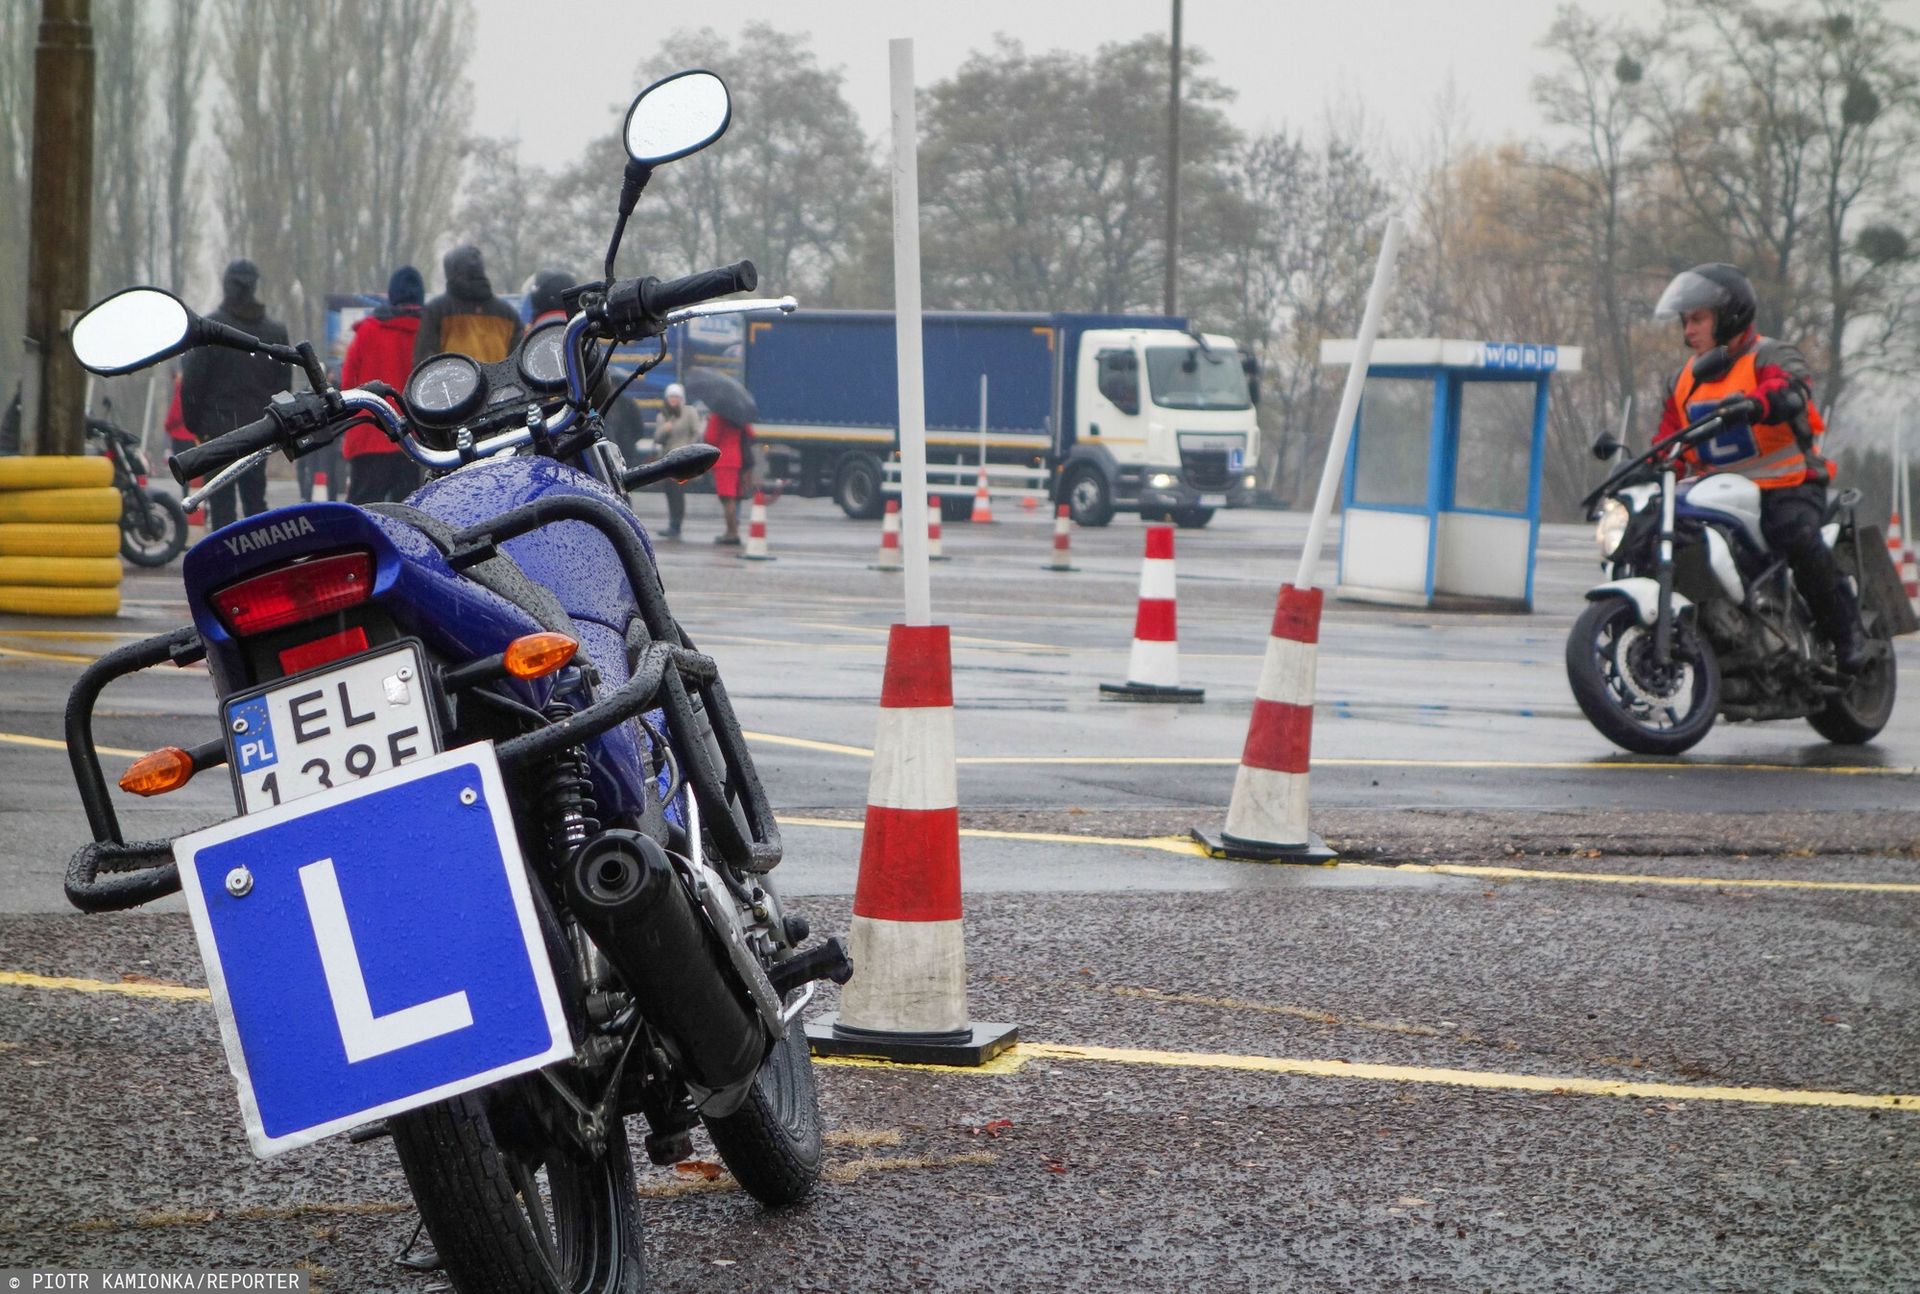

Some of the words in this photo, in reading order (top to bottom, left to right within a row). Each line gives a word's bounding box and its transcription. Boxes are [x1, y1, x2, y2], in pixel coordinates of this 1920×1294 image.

[1486, 347, 1557, 365] WORD
[224, 516, 316, 556] YAMAHA
[289, 681, 376, 744] EL
[240, 739, 273, 766] PL
[298, 857, 474, 1064] L
